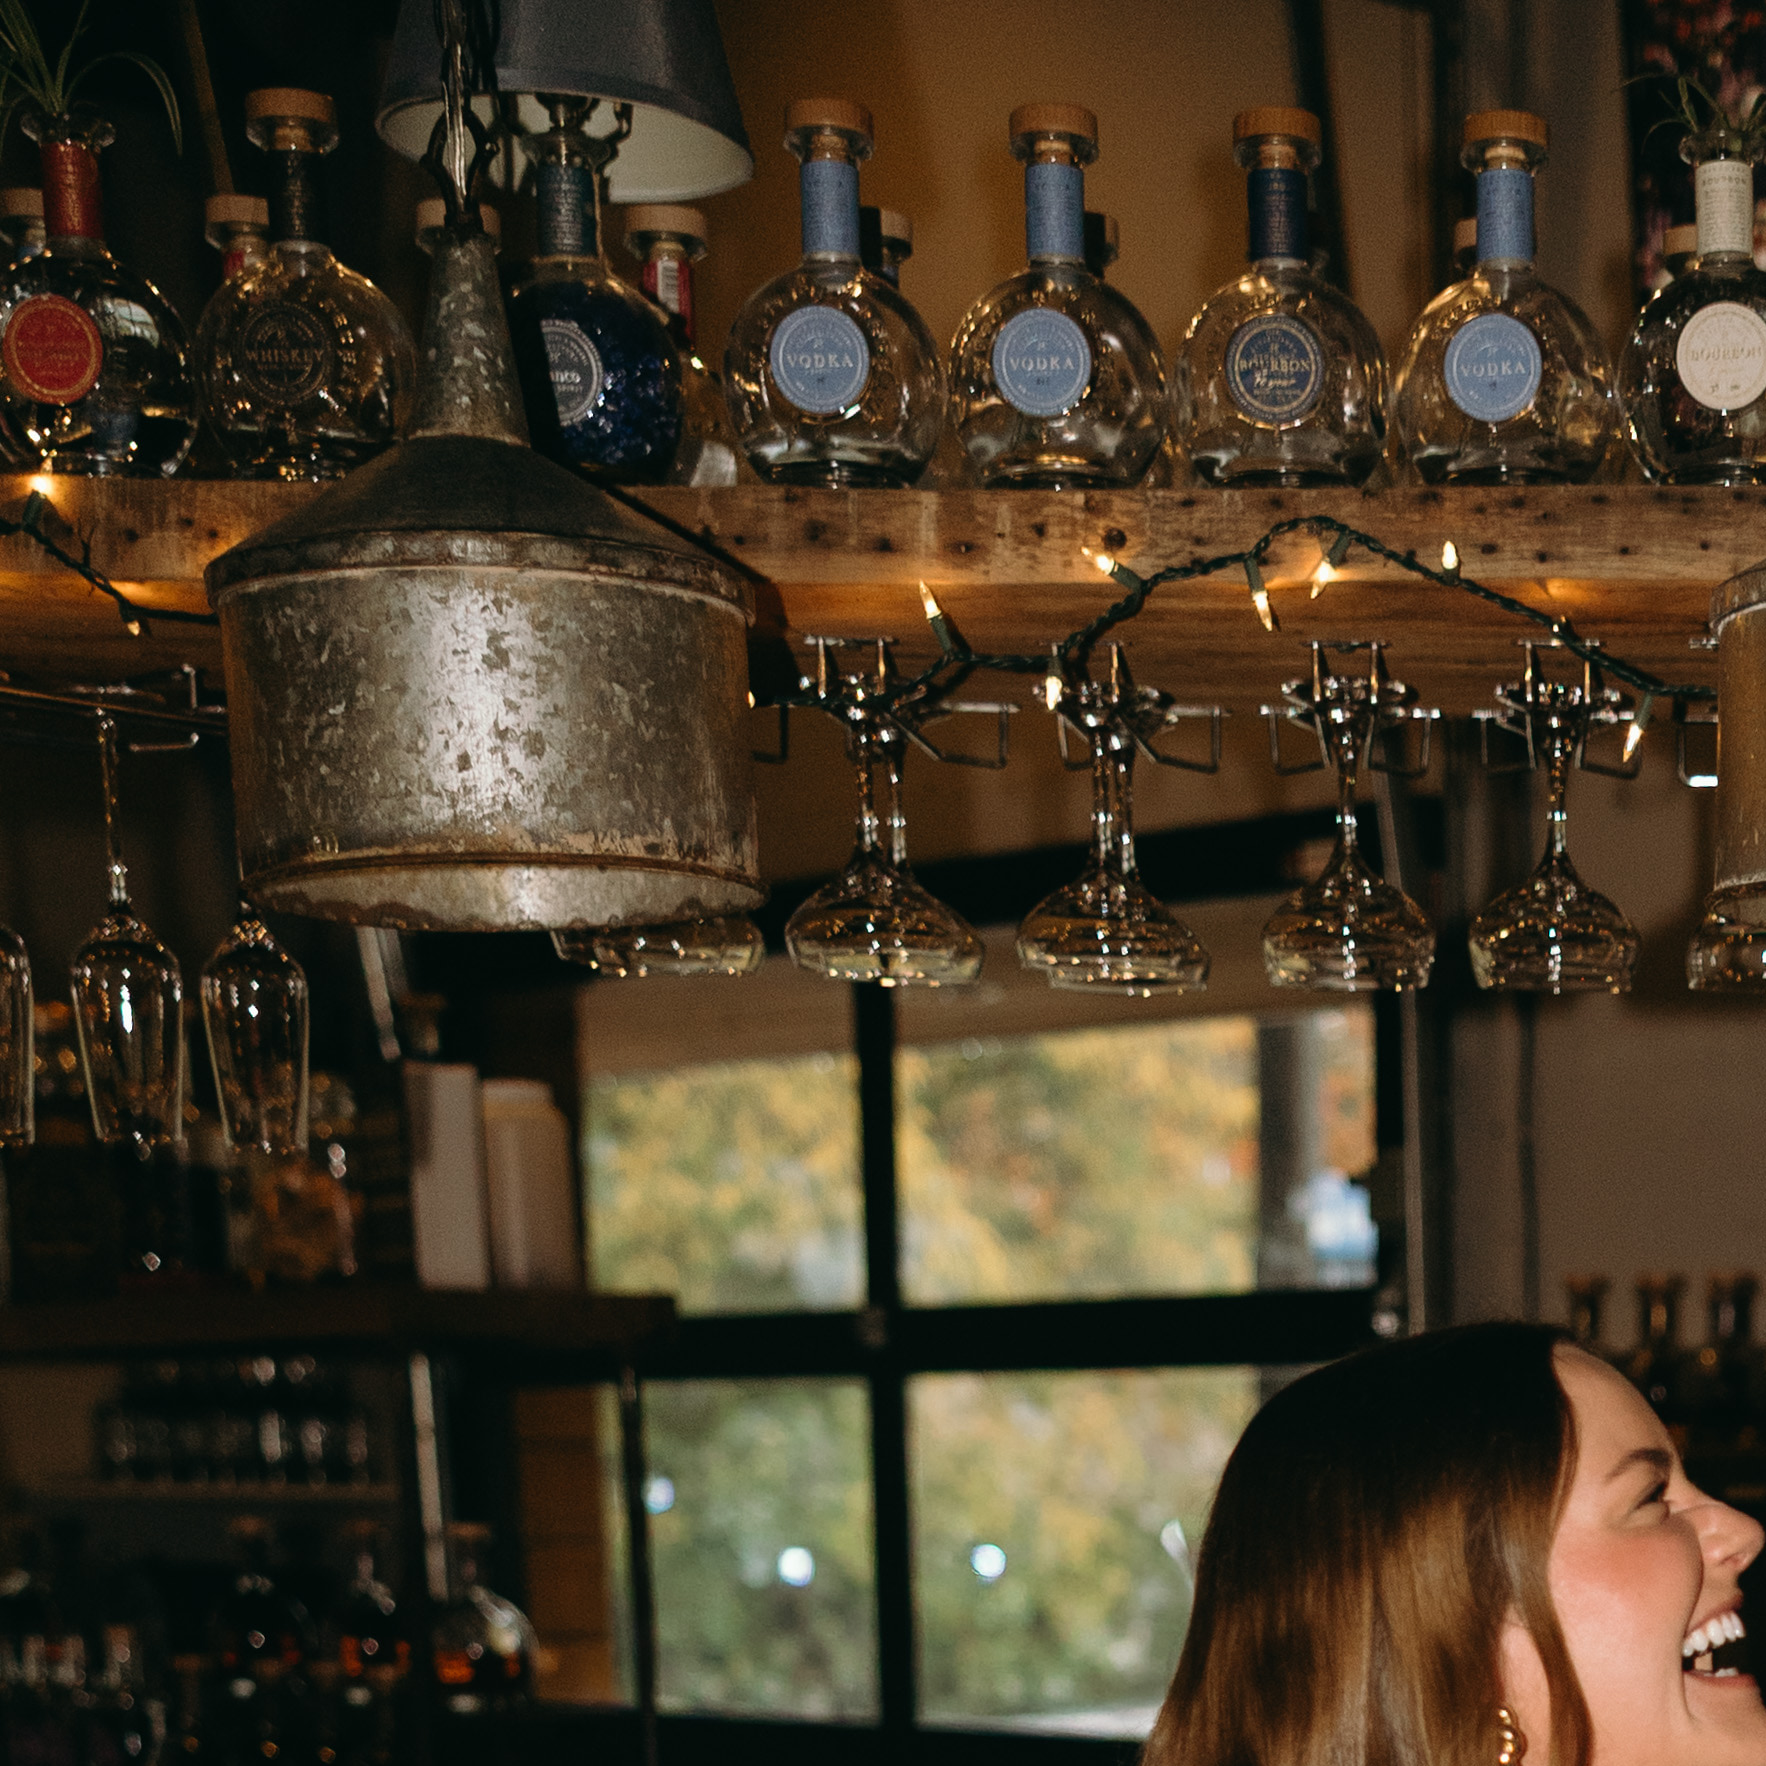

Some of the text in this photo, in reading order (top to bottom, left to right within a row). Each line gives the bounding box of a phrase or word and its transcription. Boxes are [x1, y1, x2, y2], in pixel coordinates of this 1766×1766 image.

[786, 352, 855, 369] VODKA
[1692, 346, 1762, 362] BOURBON
[1008, 356, 1075, 371] VODKA
[1240, 357, 1311, 373] BOURBON
[1460, 359, 1526, 378] VODKA
